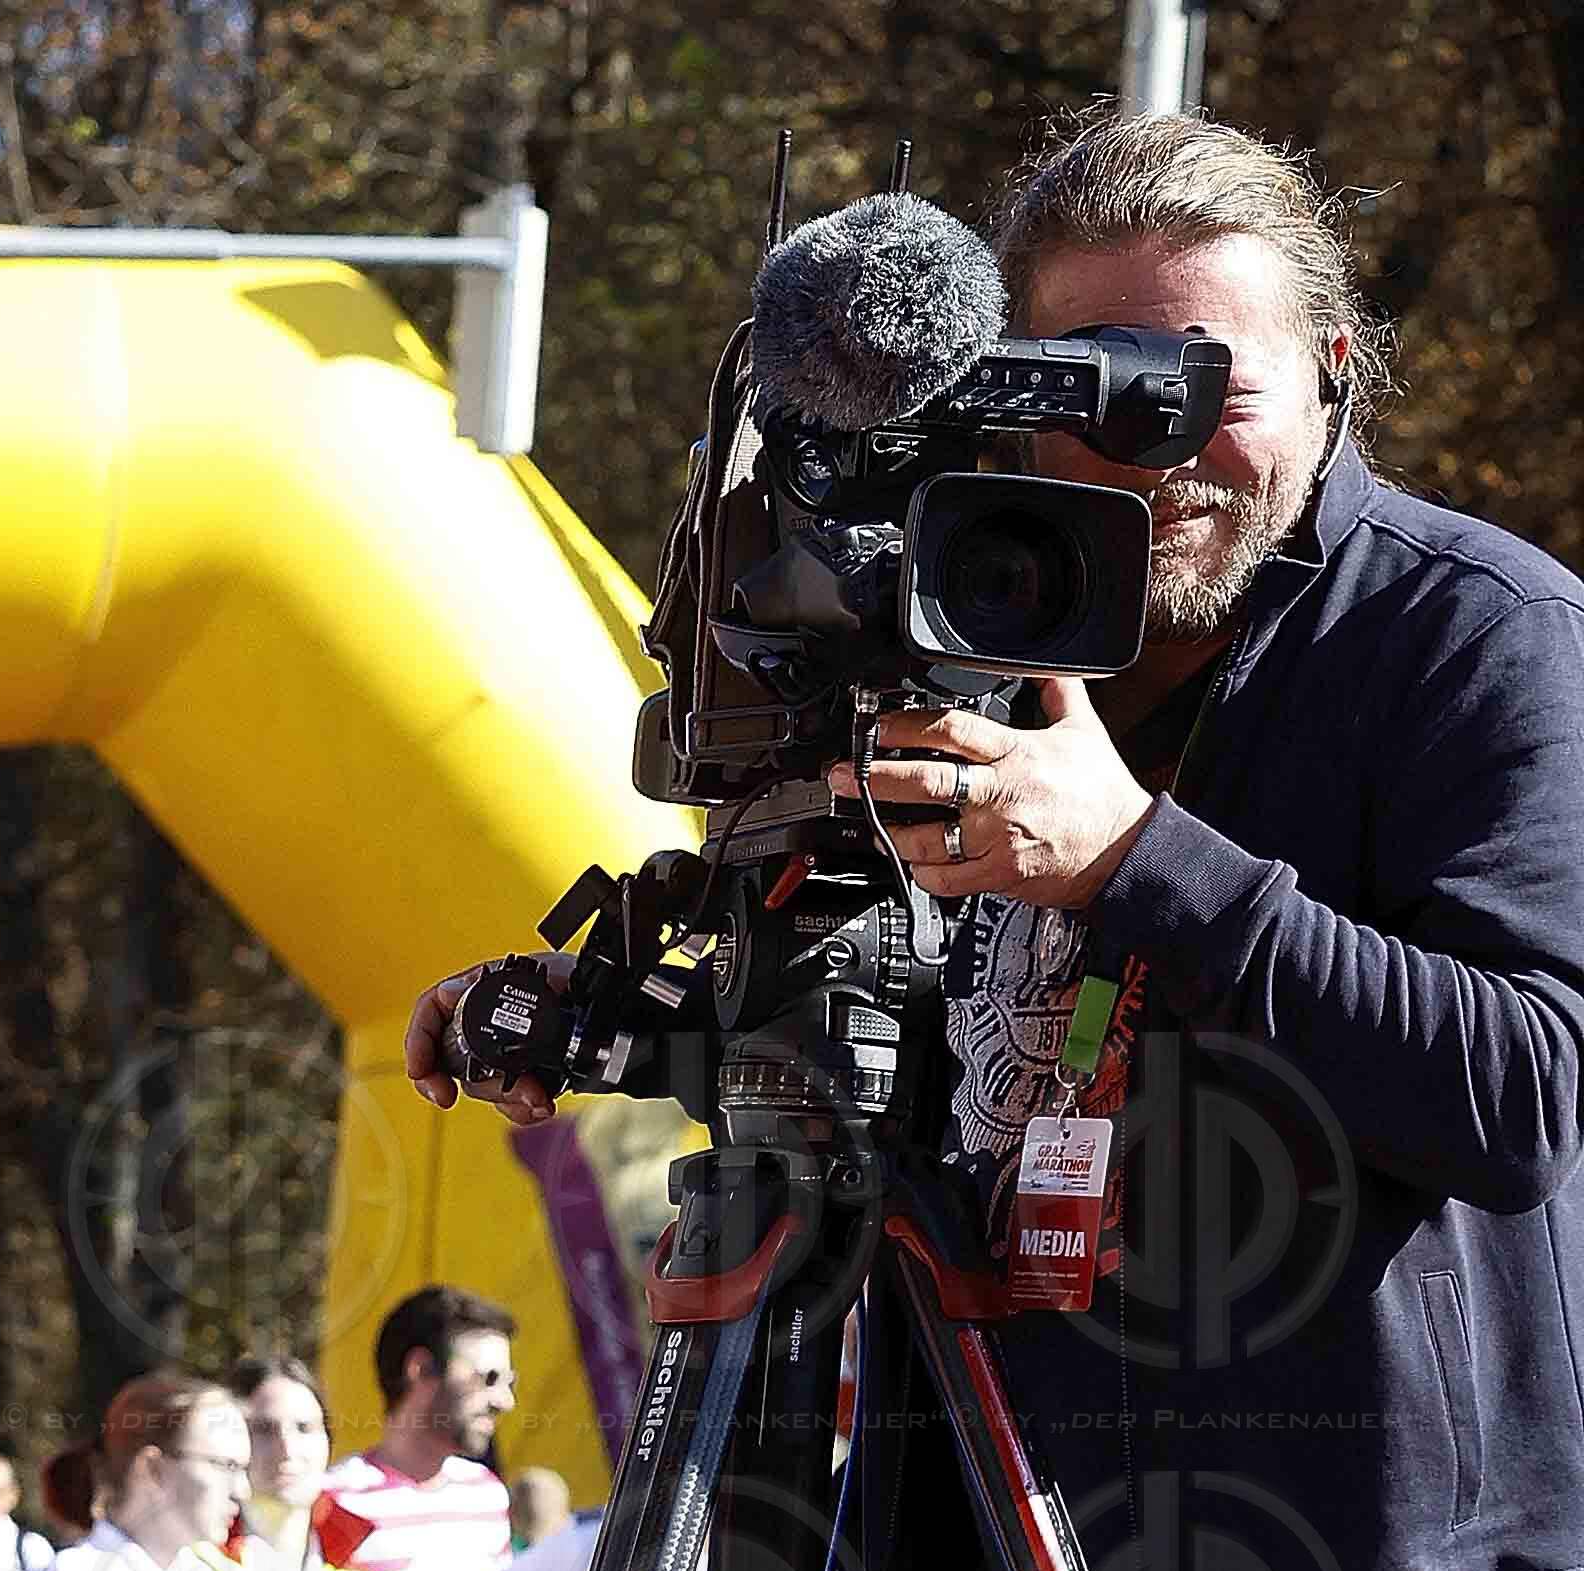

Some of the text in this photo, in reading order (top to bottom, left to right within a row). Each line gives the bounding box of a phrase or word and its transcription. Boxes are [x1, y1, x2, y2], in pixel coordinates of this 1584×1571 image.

[1032, 1158, 1093, 1172] MARATHON
[1019, 1229, 1086, 1257] MEDIA
[789, 1307, 806, 1362] sachtler
[636, 1330, 683, 1462] sachtler
